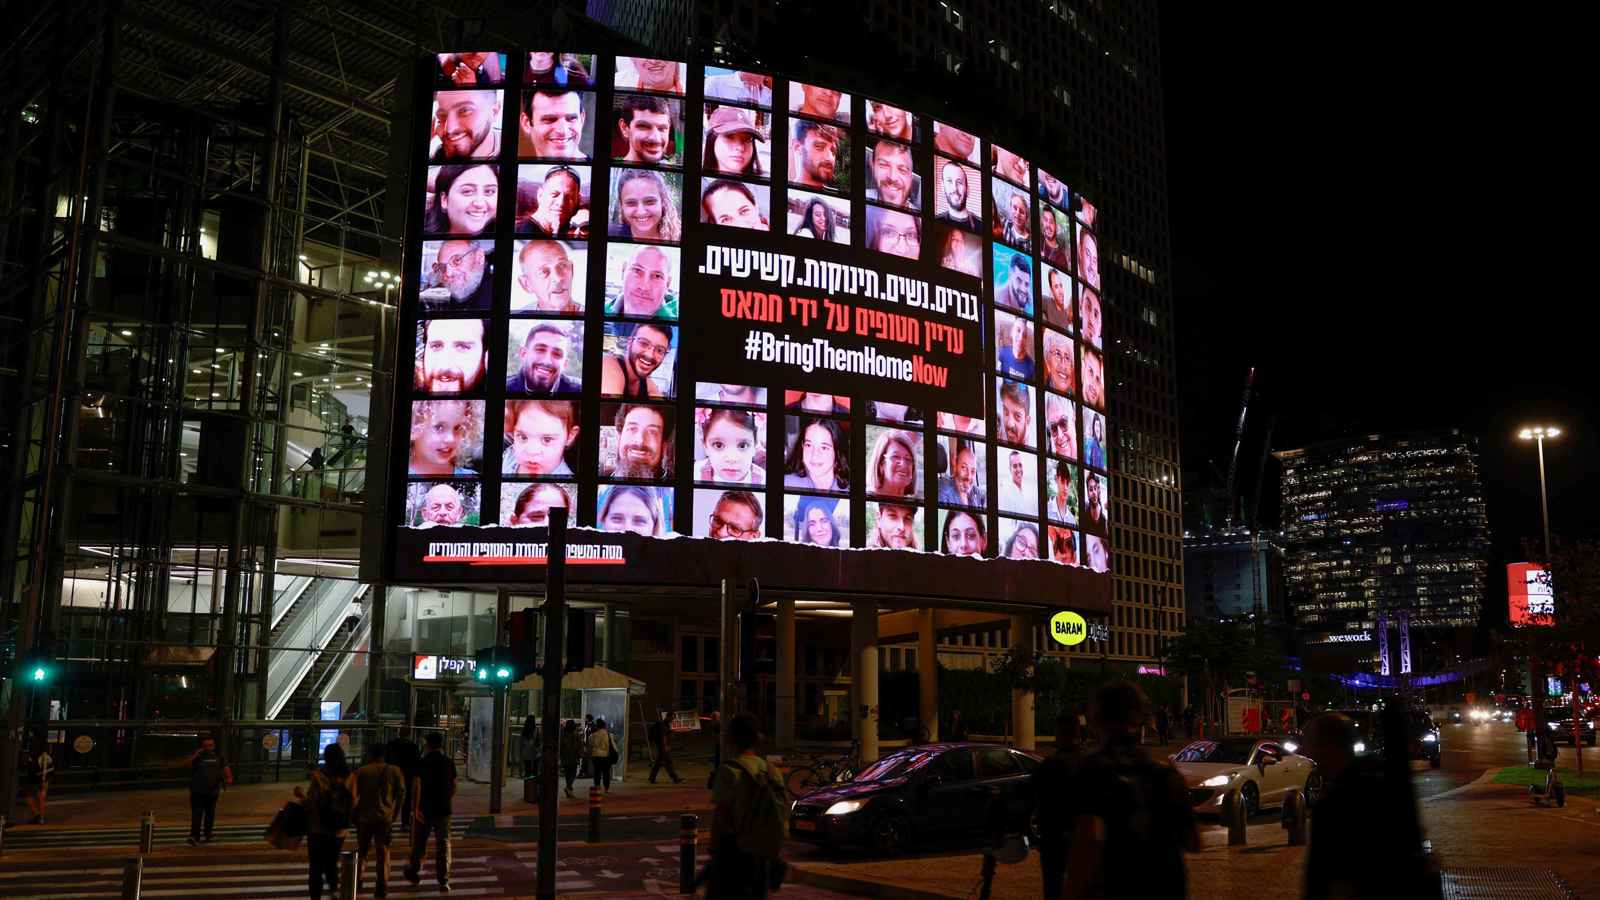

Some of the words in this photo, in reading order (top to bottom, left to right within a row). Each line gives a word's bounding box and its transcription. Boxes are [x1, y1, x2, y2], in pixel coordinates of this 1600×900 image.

[720, 288, 783, 323] חמאס
[789, 298, 817, 326] ידי
[823, 298, 849, 332] על
[855, 307, 920, 345] חטופים
[924, 320, 965, 355] עדיין
[745, 330, 948, 388] #BringThemHomeNow
[429, 542, 471, 557] והנעדרים
[472, 542, 513, 558] החטופים
[515, 542, 549, 558] החזרת
[565, 543, 601, 559] המשפח
[602, 544, 623, 560] מטה
[1055, 621, 1083, 635] BARAM
[1328, 631, 1372, 642] wework
[439, 656, 465, 674] קפלן
